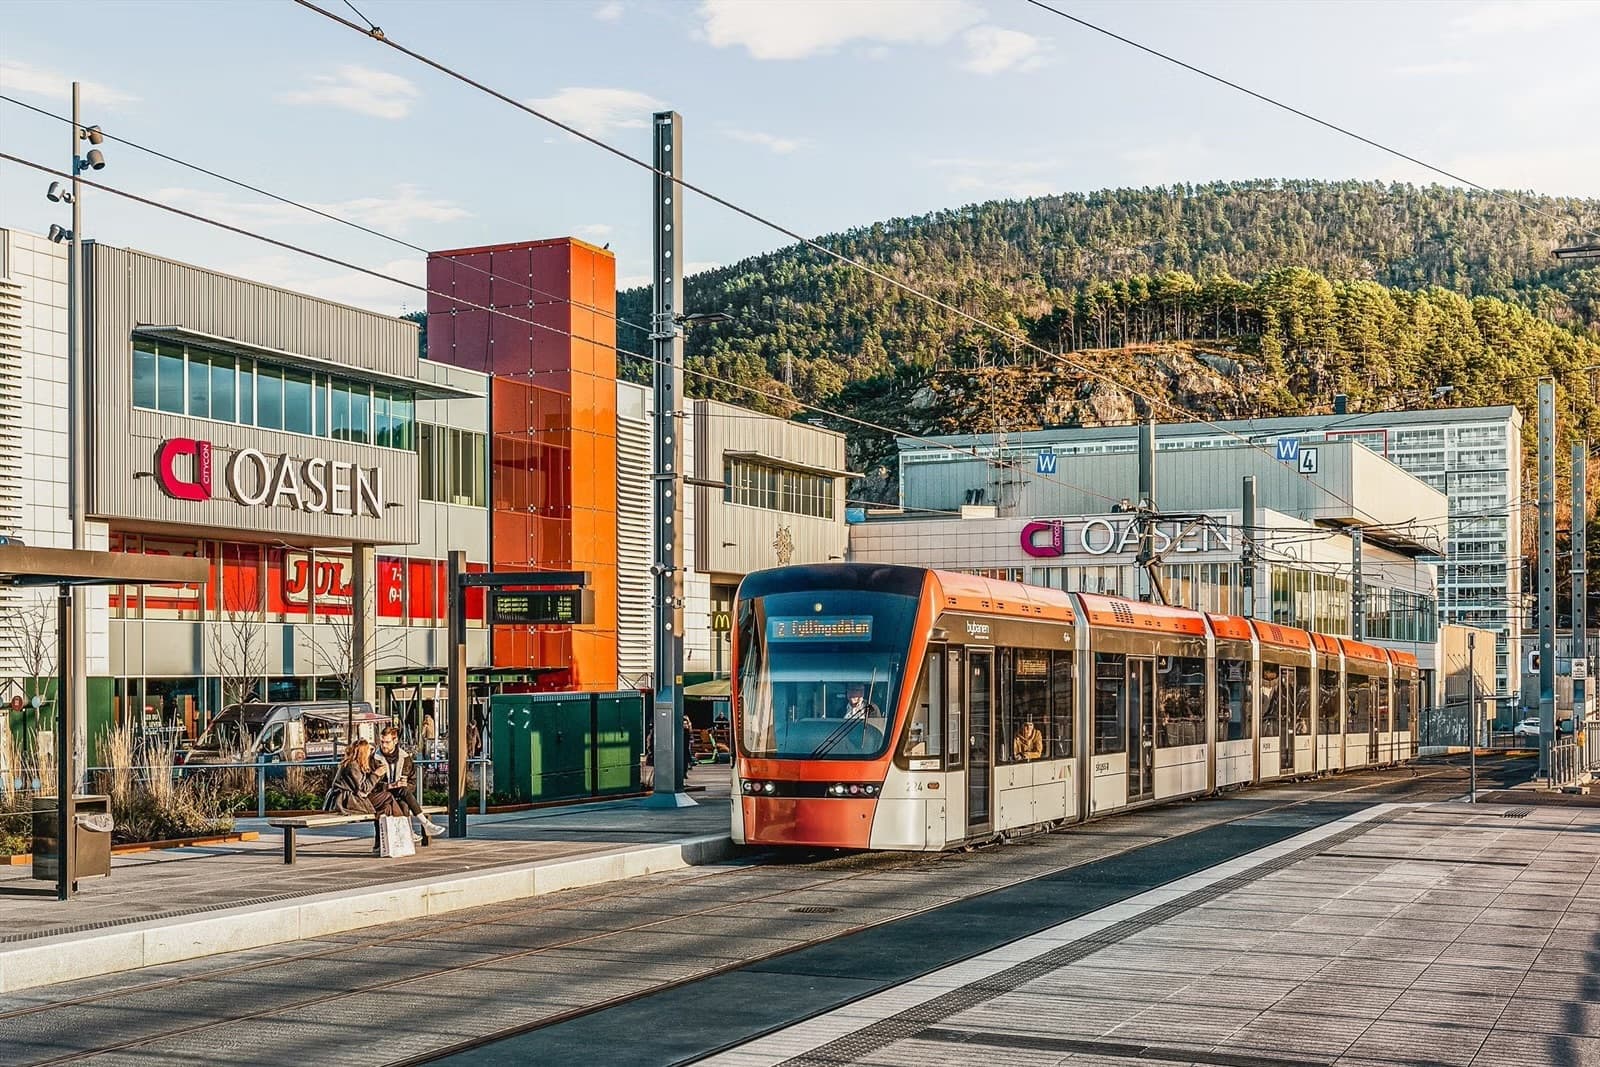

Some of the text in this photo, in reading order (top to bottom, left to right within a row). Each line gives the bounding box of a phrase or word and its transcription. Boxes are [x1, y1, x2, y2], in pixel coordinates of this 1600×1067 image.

[203, 443, 211, 485] CITYCON
[1039, 454, 1056, 472] W
[1278, 440, 1298, 459] W
[1302, 450, 1314, 471] 4
[226, 448, 383, 519] OASEN
[1081, 514, 1232, 556] OASEN
[286, 560, 353, 596] JUL
